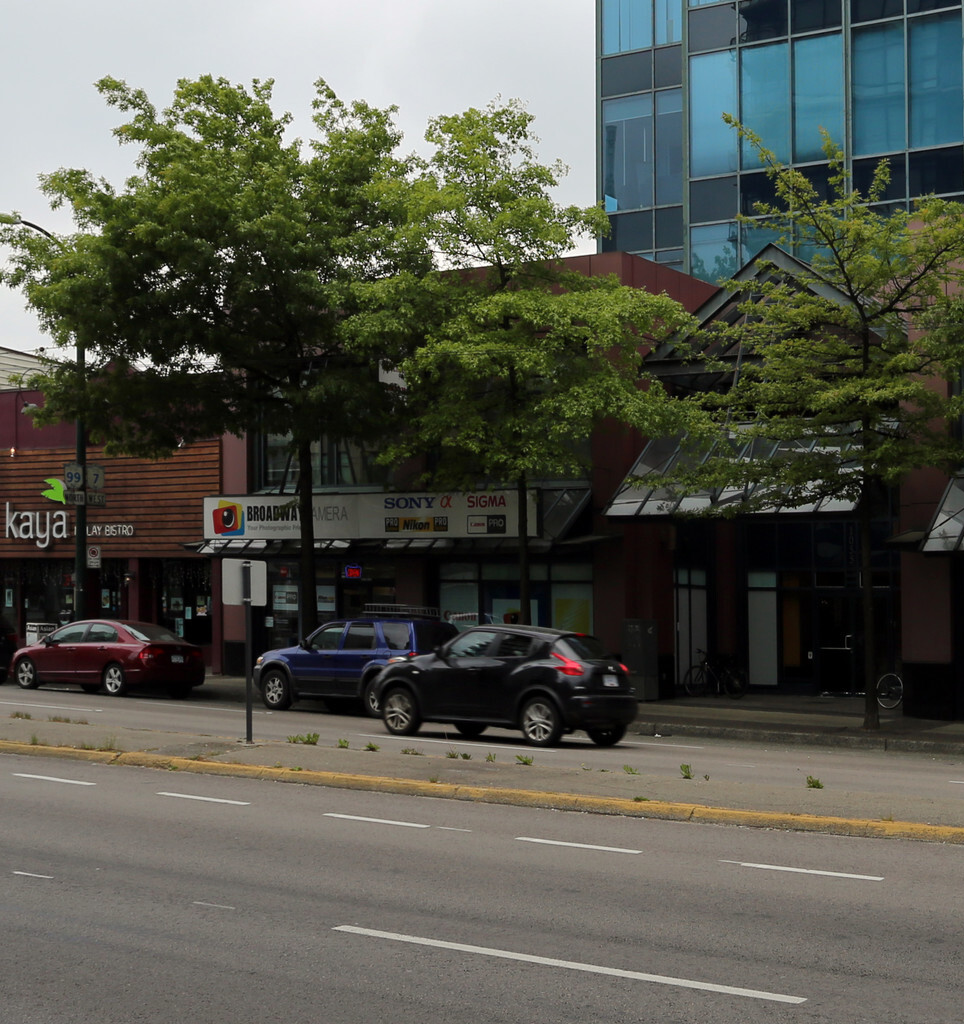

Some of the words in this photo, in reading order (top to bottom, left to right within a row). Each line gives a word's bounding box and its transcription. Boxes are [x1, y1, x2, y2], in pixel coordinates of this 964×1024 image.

[66, 472, 81, 483] 99
[93, 473, 99, 484] 7
[384, 497, 435, 509] SONY
[467, 495, 506, 508] SIGMA
[312, 506, 348, 522] AMERA
[5, 501, 67, 548] kaya
[385, 518, 398, 526] PRO
[402, 519, 430, 530] Nikon
[434, 517, 447, 526] PRO
[488, 518, 504, 528] PRO
[104, 525, 134, 536] BISTRO
[443, 609, 477, 622] Canon
